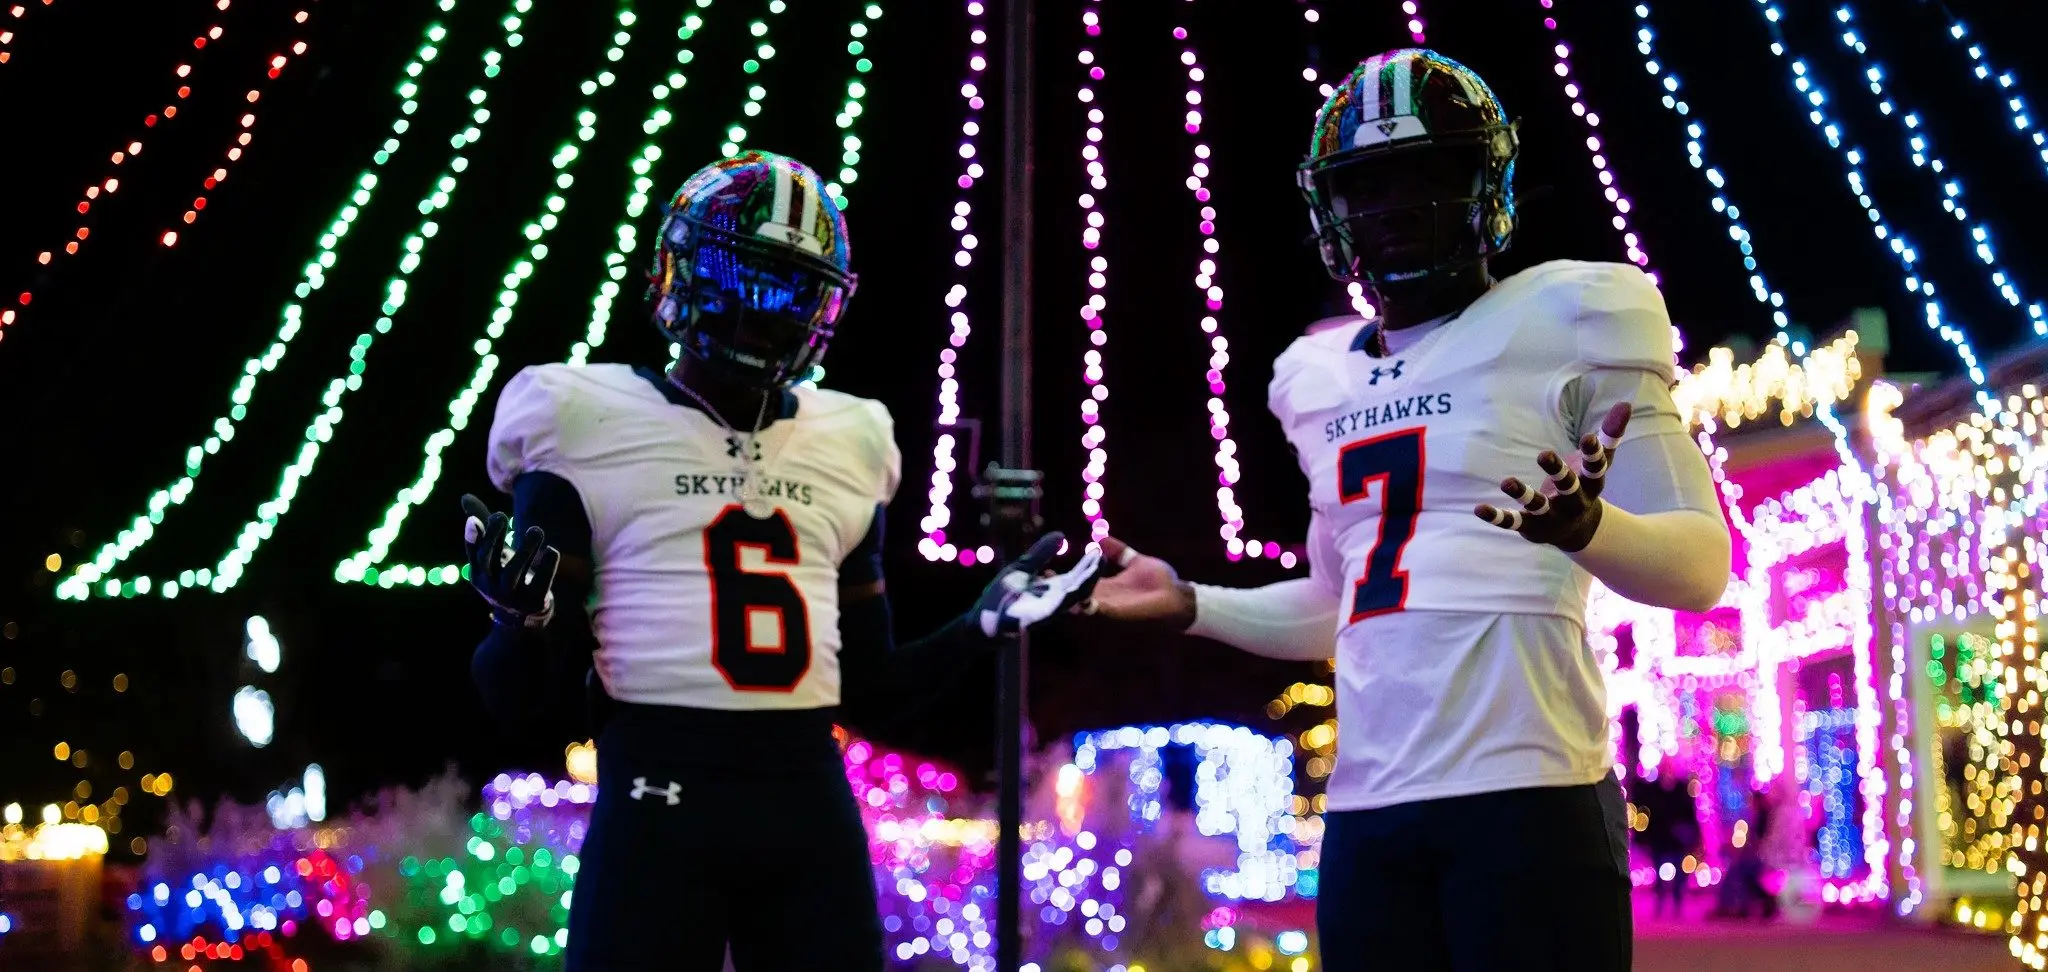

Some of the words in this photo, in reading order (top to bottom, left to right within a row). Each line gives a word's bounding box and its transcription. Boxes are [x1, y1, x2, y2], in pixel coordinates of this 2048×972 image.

[1325, 393, 1452, 442] SKYHAWKS
[675, 474, 812, 505] SKYHWKS
[1337, 425, 1427, 625] 7
[703, 503, 813, 693] 6
